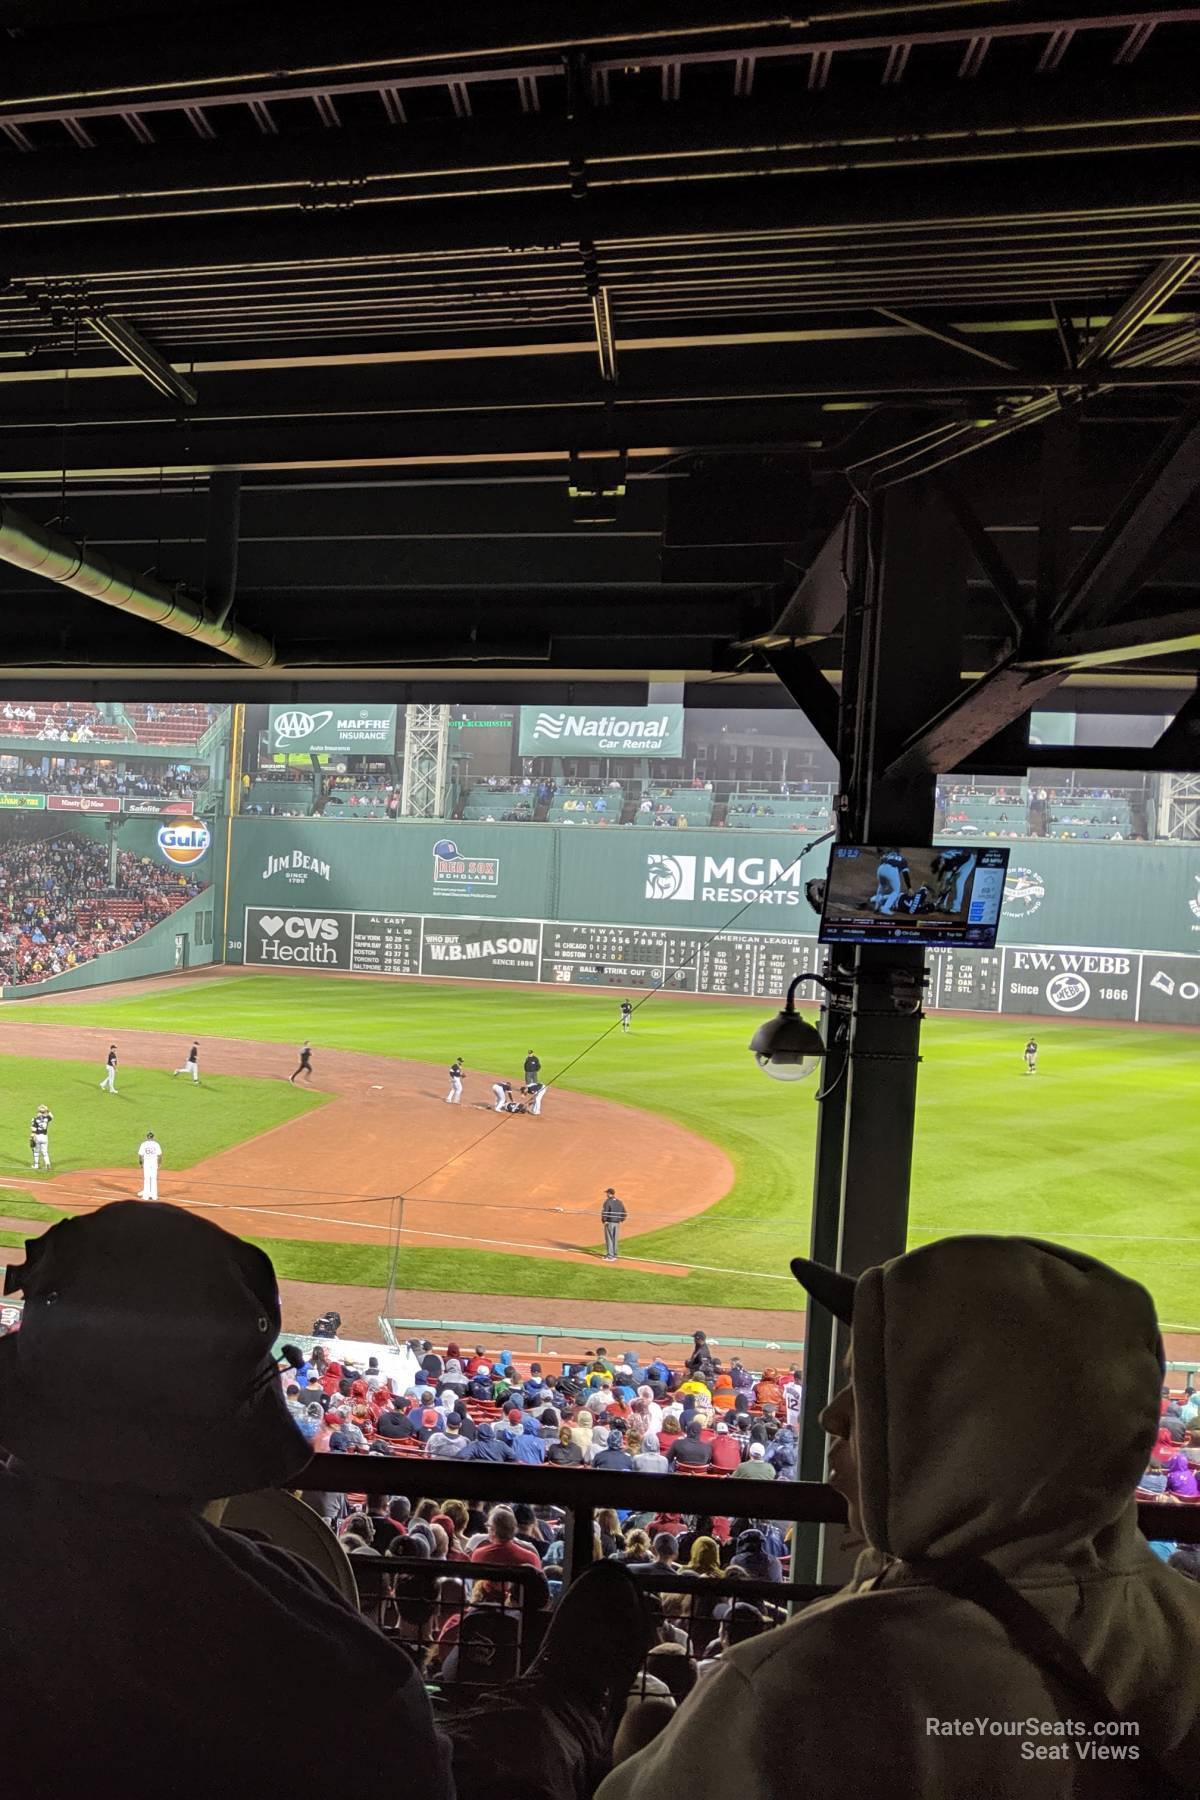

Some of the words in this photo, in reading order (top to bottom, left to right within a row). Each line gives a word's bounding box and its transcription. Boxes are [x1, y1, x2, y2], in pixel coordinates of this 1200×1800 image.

[337, 719, 390, 729] MAPFRE
[564, 716, 668, 737] National
[339, 732, 387, 741] INSURANCE
[598, 739, 620, 749] Car
[623, 739, 662, 749] Rental
[160, 830, 208, 847] Gulf
[263, 855, 290, 879] JIM
[292, 850, 330, 881] BEAM
[439, 861, 465, 873] RED
[468, 862, 494, 874] SOX
[703, 856, 802, 887] MGM
[702, 887, 800, 905] RESORTS
[285, 916, 339, 940] CVS
[228, 941, 242, 949] 310
[714, 935, 760, 943] AMERICAN
[764, 937, 800, 945] LEAGUE
[260, 939, 338, 963] Health
[1013, 952, 1056, 971] F.W.
[1060, 954, 1130, 975] WEBB
[1010, 983, 1039, 995] Since
[1099, 988, 1128, 1000] 1866
[1057, 983, 1081, 1000] WEBB
